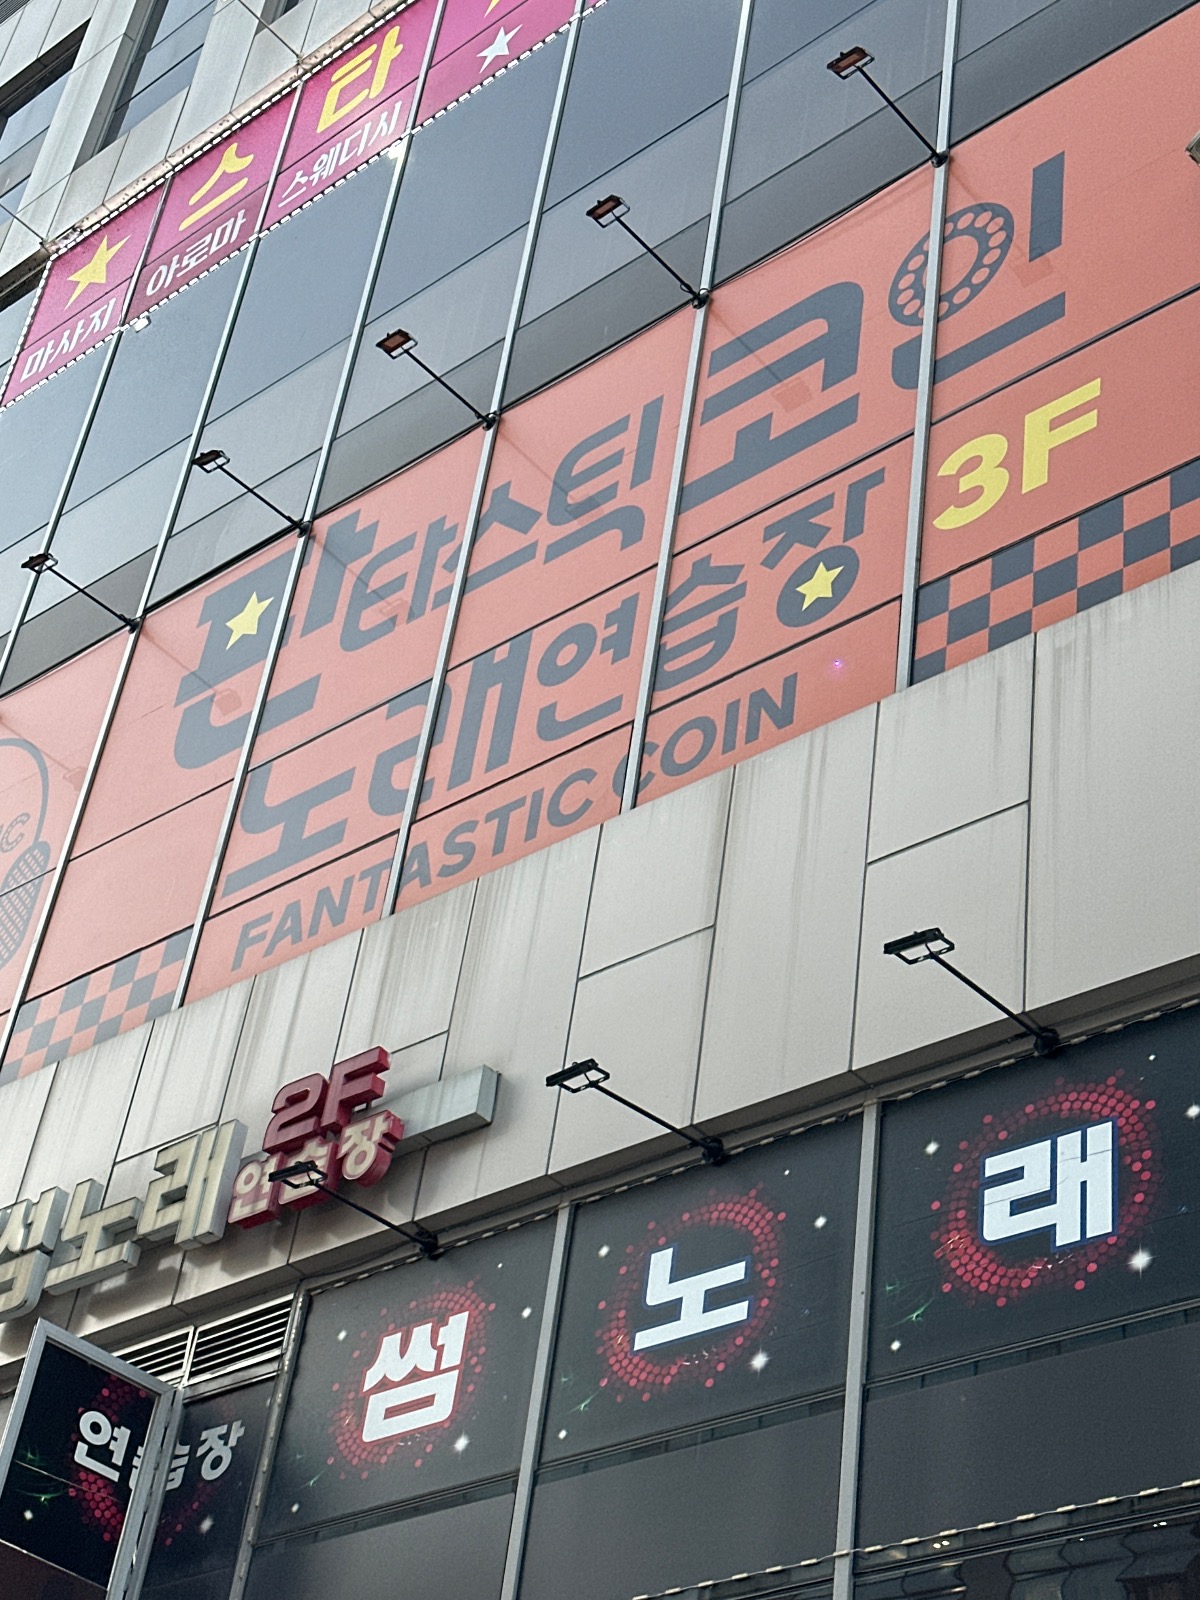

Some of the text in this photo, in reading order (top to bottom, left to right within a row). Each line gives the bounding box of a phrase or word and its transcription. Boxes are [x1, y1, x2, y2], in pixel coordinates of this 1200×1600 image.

[20, 101, 402, 384] 마사지 아로마 스웨디시
[932, 377, 1101, 530] 3F
[221, 466, 886, 898] 노래연습장
[231, 672, 797, 972] FANTASTIC COIN
[263, 1045, 391, 1155] 2F
